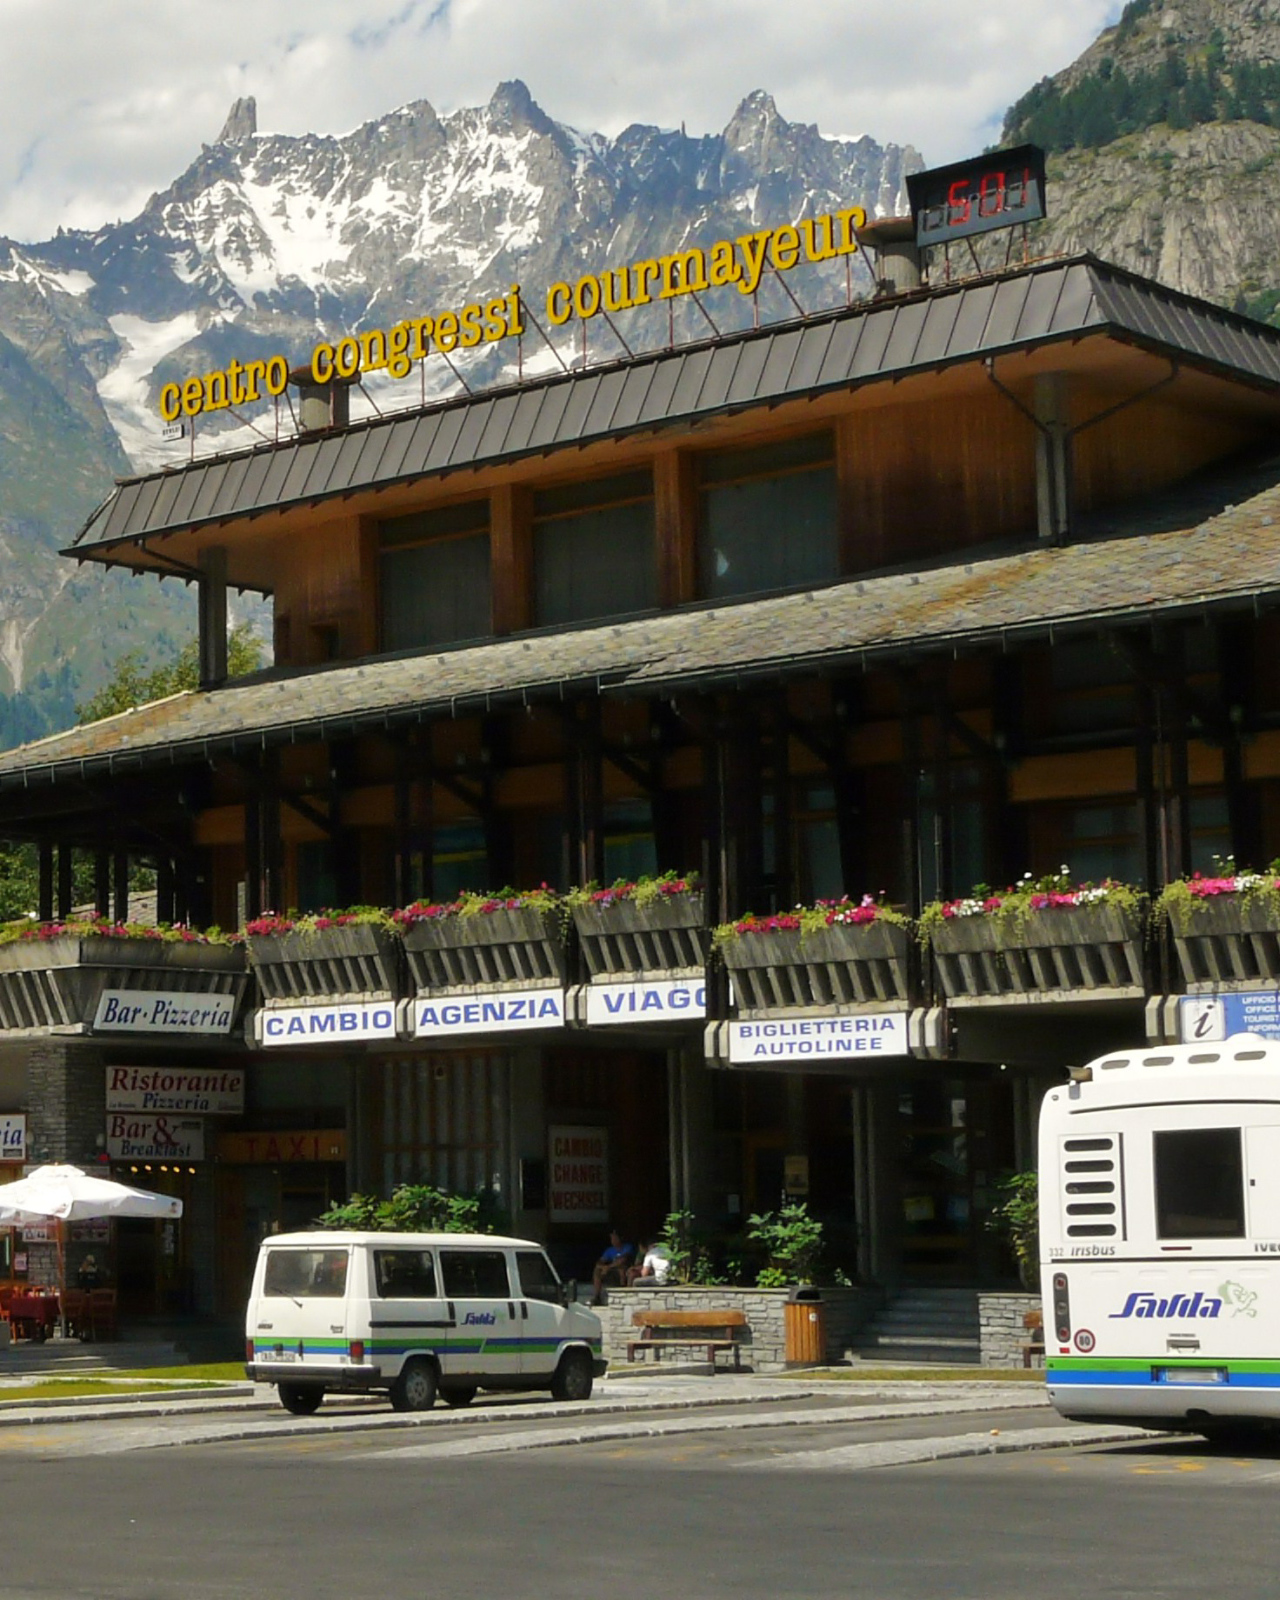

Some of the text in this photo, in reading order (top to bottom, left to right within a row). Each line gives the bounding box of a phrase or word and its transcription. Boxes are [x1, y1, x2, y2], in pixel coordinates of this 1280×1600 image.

[160, 206, 867, 421] centro congressi courmayeur
[150, 1000, 230, 1027] Pizzeria
[420, 998, 560, 1027] AGENZIA
[266, 1010, 392, 1036] CAMBIO
[739, 1018, 895, 1038] BIGLIETTERIA
[753, 1037, 883, 1056] AUTOLINEE
[110, 1068, 240, 1092] Ristorante
[142, 1093, 209, 1110] Pizzeria
[110, 1115, 151, 1138] Bar
[121, 1139, 191, 1157] Breakfast
[248, 1136, 319, 1161] TAXI
[555, 1137, 602, 1157] CAMBIO
[554, 1164, 602, 1183] CHANGE
[552, 1190, 604, 1210] WECHSEL
[1071, 1244, 1116, 1257] irisbus
[1254, 1243, 1280, 1252] IVE
[1108, 1292, 1222, 1318] Savda
